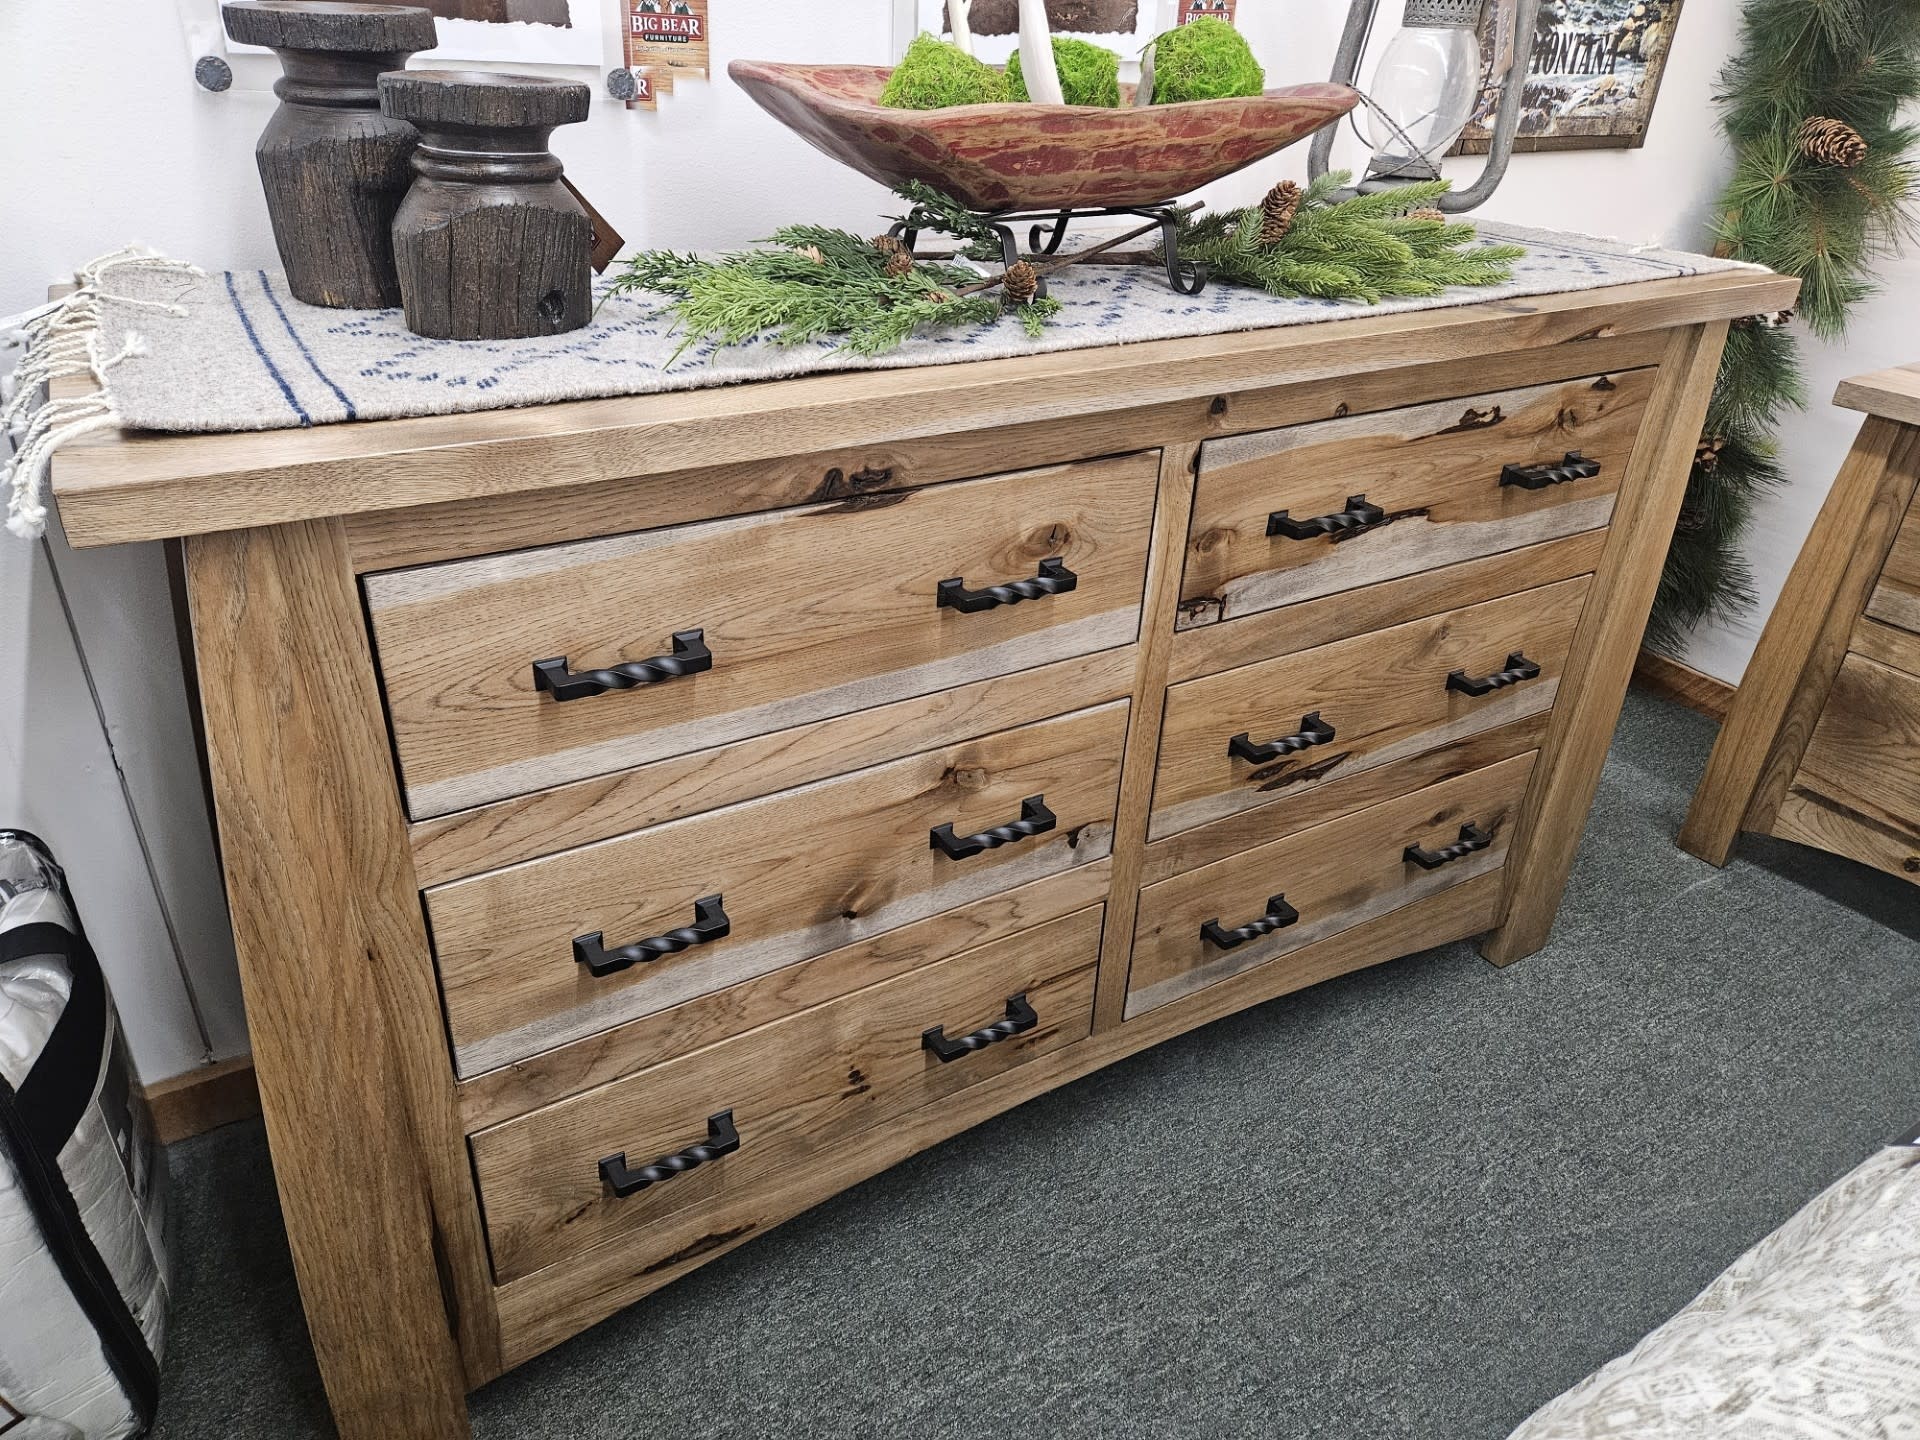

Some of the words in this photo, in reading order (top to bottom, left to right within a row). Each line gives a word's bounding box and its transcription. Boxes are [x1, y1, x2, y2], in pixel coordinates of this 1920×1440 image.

[631, 15, 658, 32] BIG
[661, 18, 701, 36] BEAR
[645, 34, 688, 42] FURNITURE
[1527, 32, 1619, 74] MONTANA
